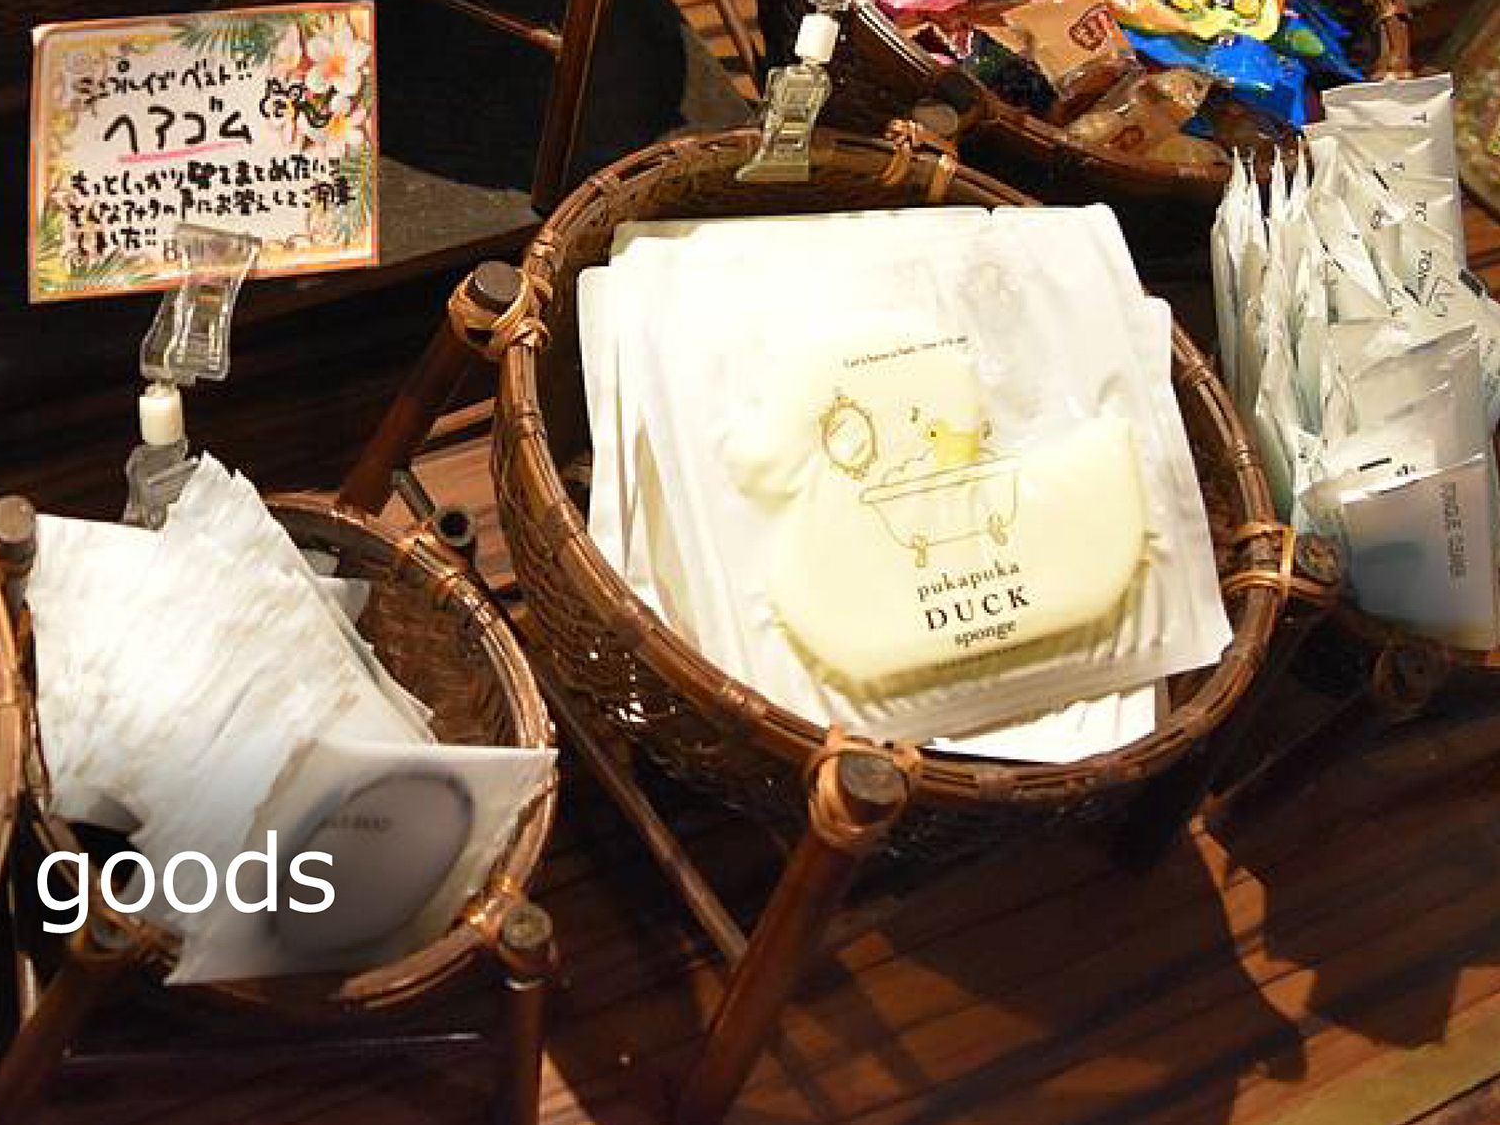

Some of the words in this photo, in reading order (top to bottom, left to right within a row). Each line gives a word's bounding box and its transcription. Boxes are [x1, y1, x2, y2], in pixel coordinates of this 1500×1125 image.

[102, 95, 253, 155] ヘアゴム
[917, 559, 1021, 602] pukapuka
[924, 585, 1032, 632] DUCK
[954, 618, 1018, 648] sponge
